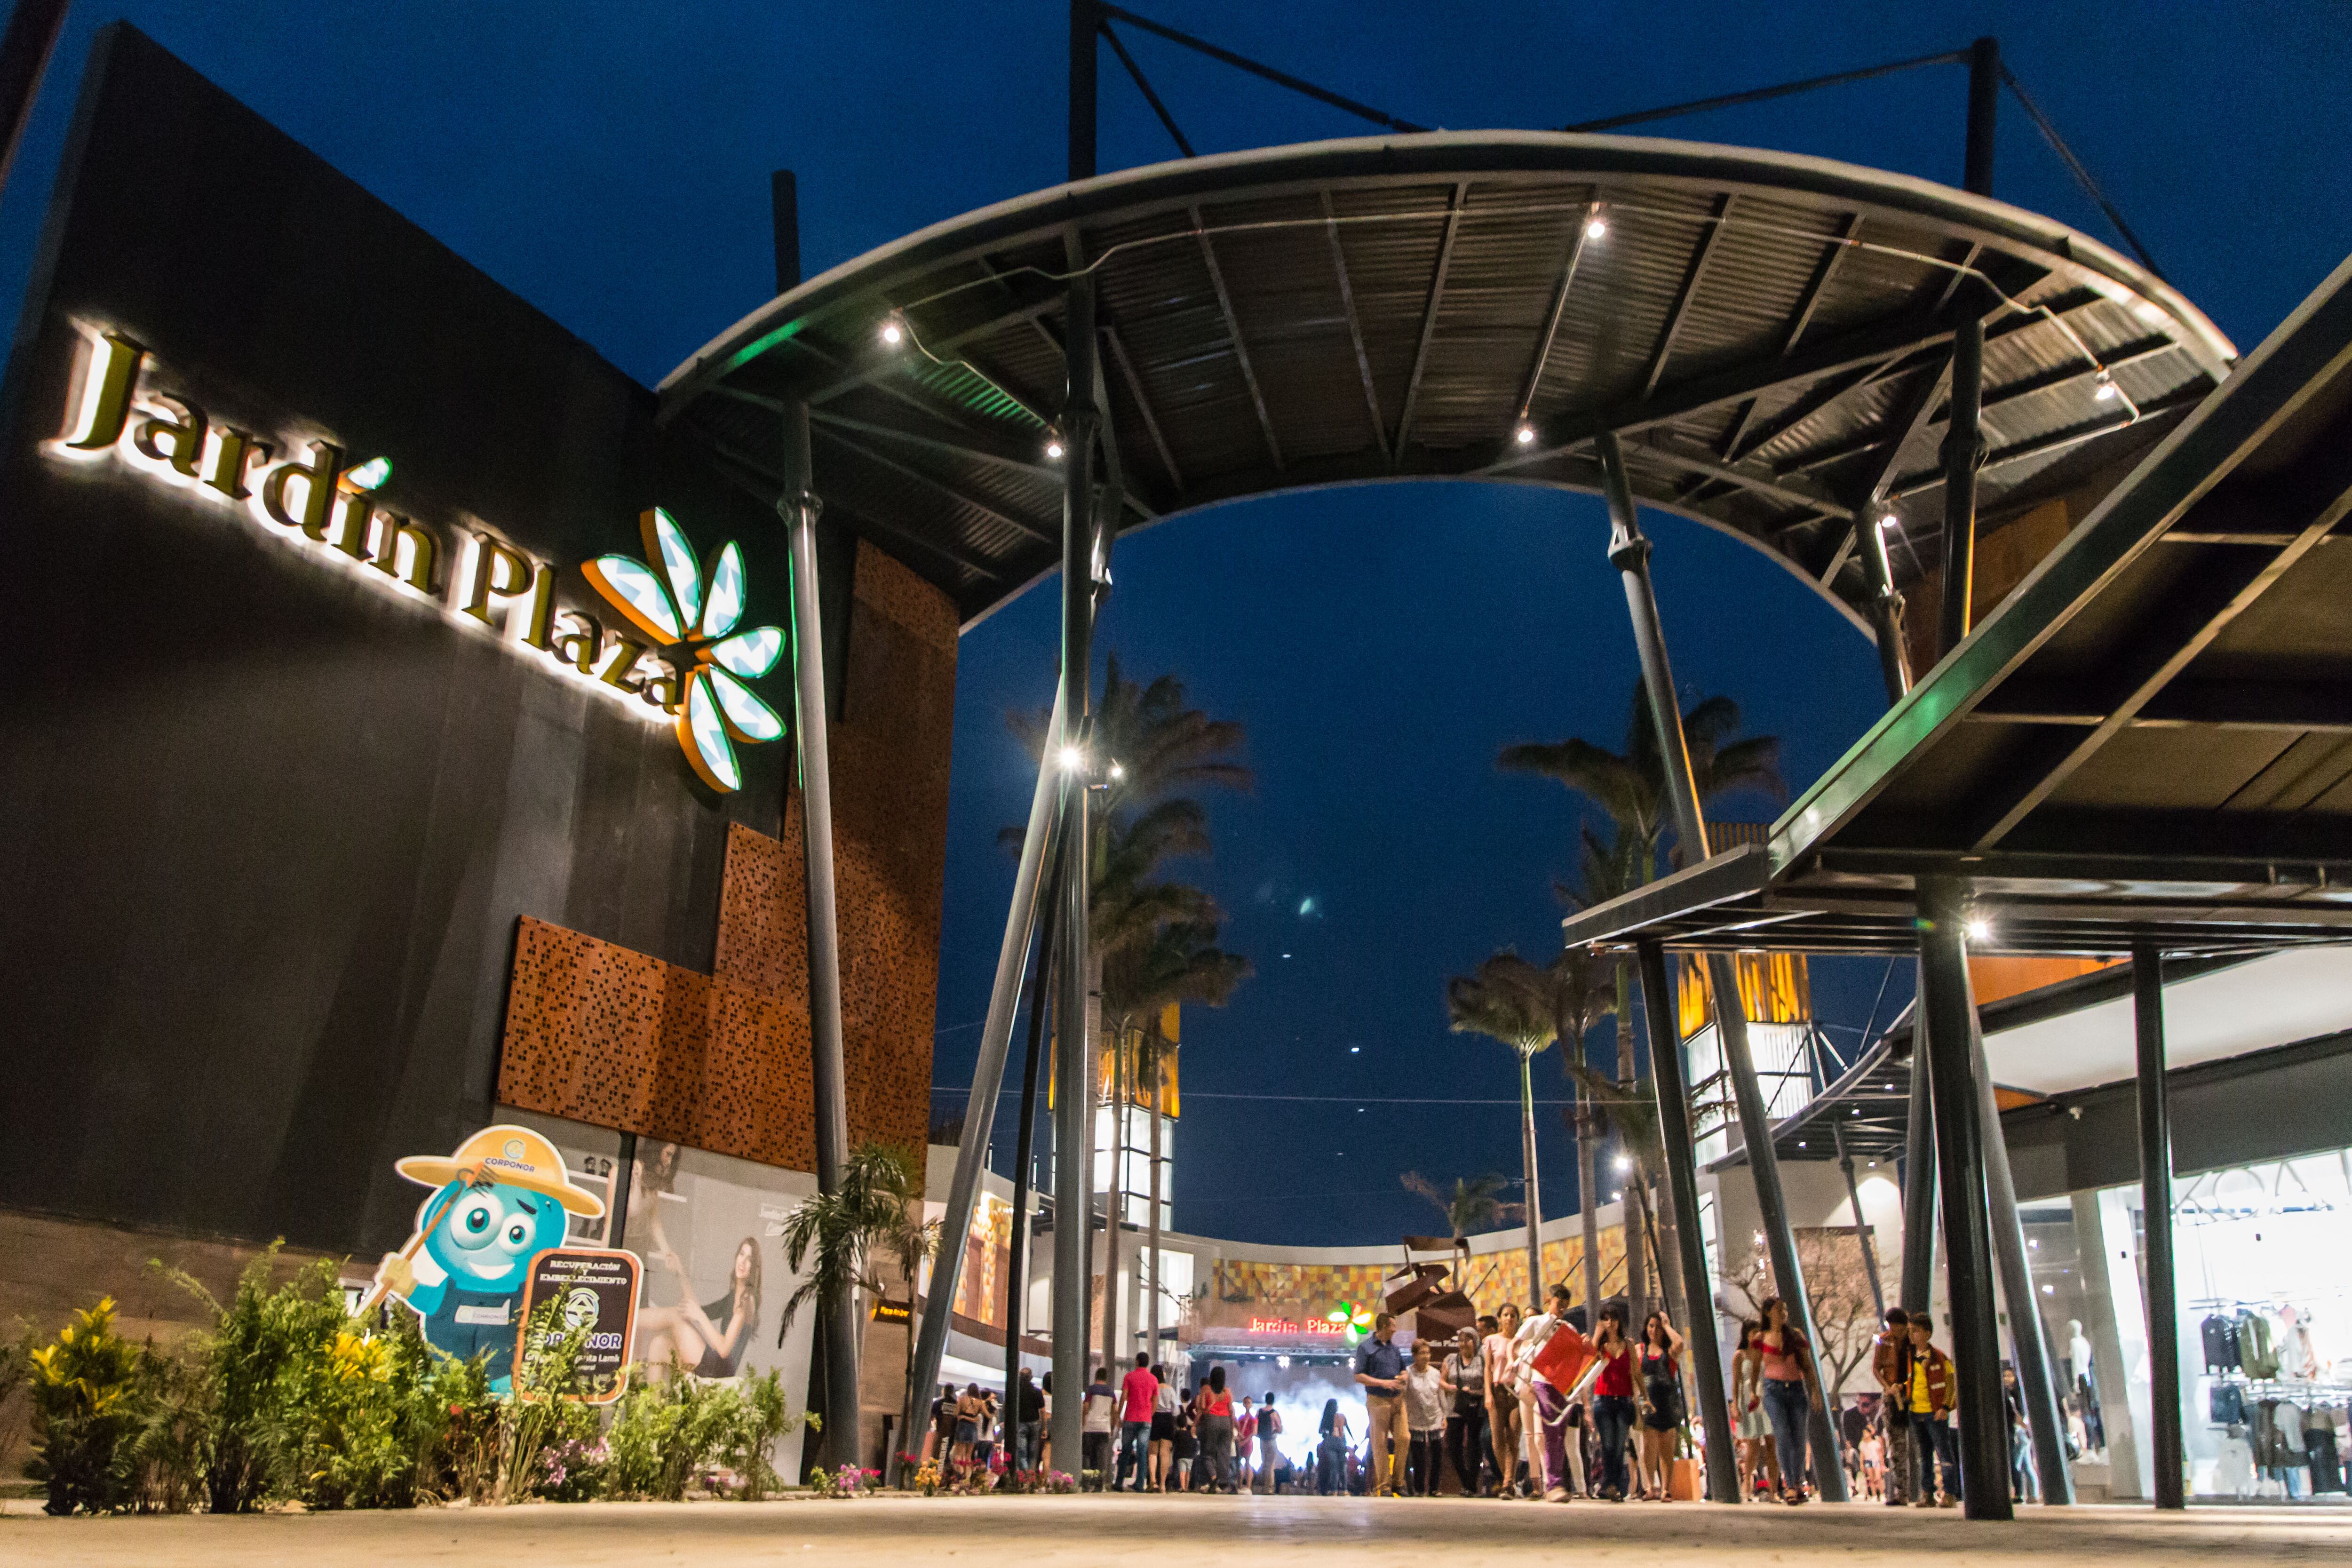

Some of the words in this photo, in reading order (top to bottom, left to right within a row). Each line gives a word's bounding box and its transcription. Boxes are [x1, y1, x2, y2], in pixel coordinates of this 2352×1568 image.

[66, 331, 441, 595] Jardín
[461, 532, 684, 716] Plaza
[485, 1157, 535, 1173] CORPONOR
[1307, 1319, 1346, 1334] Plaza
